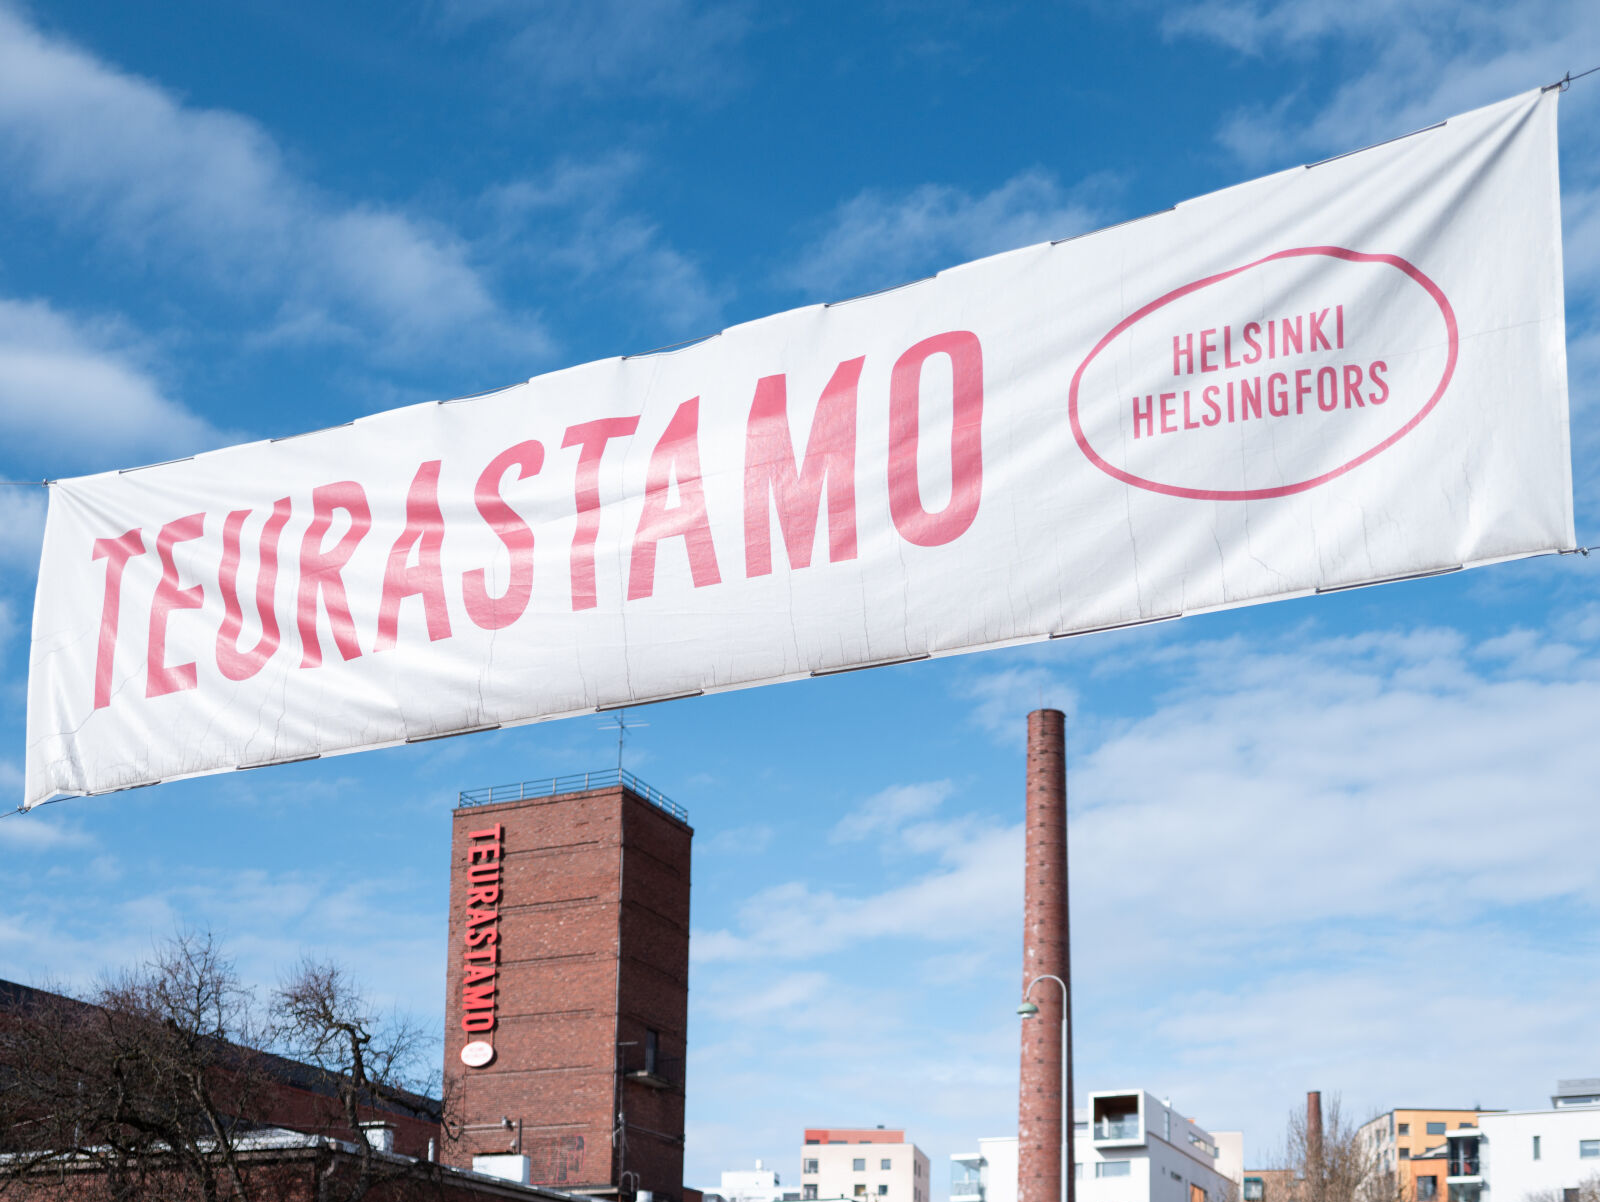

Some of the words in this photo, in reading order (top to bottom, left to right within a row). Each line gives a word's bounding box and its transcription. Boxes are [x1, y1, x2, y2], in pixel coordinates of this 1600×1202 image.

[1132, 360, 1390, 439] HELSINGFORS
[1172, 304, 1345, 377] HELSINKI
[92, 330, 984, 710] TEURASTAMO
[460, 822, 501, 1032] TEURASTAMO
